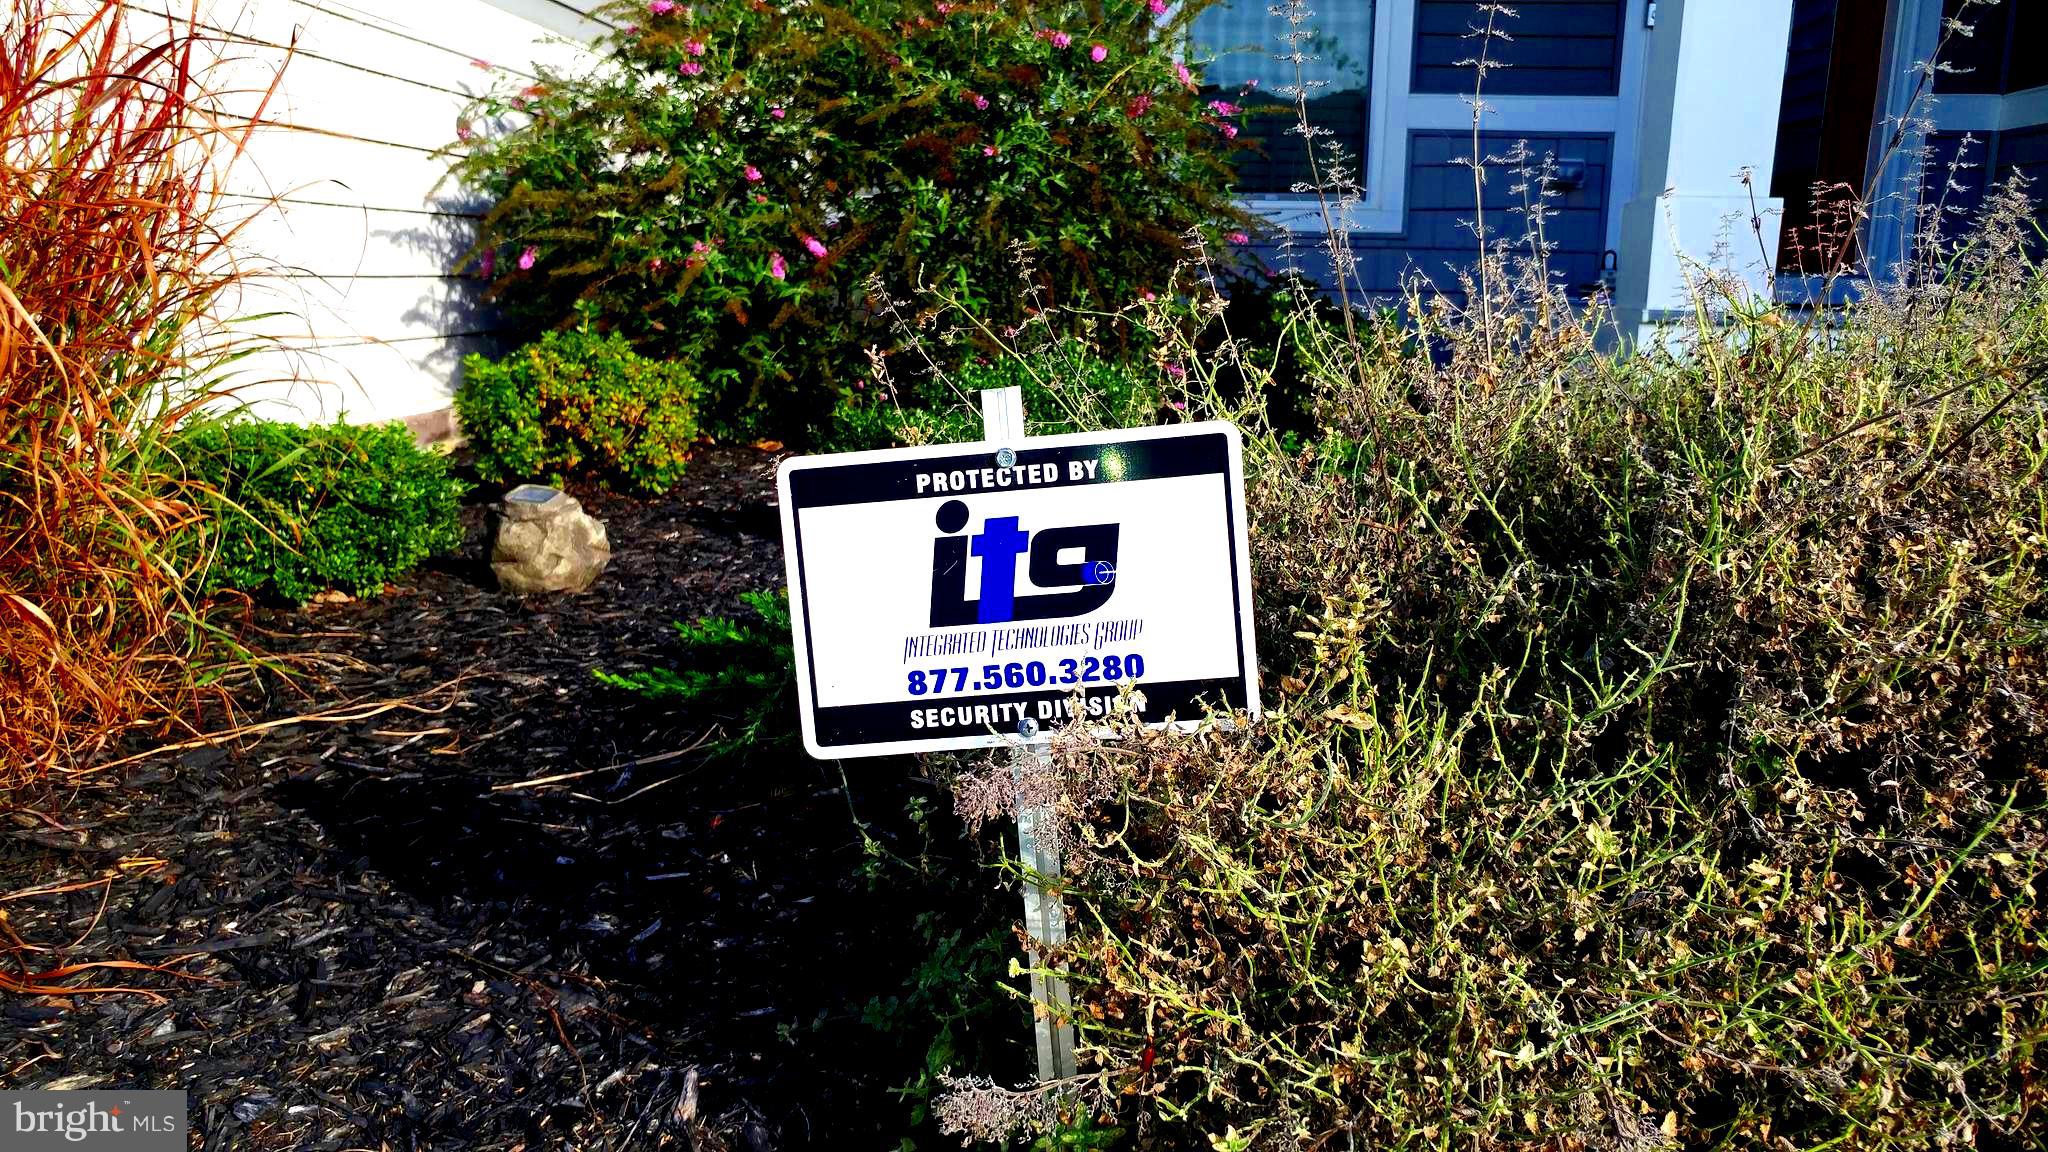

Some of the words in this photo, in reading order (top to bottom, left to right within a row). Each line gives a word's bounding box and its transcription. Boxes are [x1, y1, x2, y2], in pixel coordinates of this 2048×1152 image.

[916, 463, 1059, 494] PROTECTED
[1068, 459, 1099, 481] BY
[929, 500, 1120, 628] itg
[904, 630, 987, 665] INTEGRATED
[991, 622, 1091, 658] TECHNOLOGIES
[1094, 618, 1143, 650] GROUP
[907, 653, 1145, 696] 877.560.3280
[910, 701, 1028, 729] SECURITY
